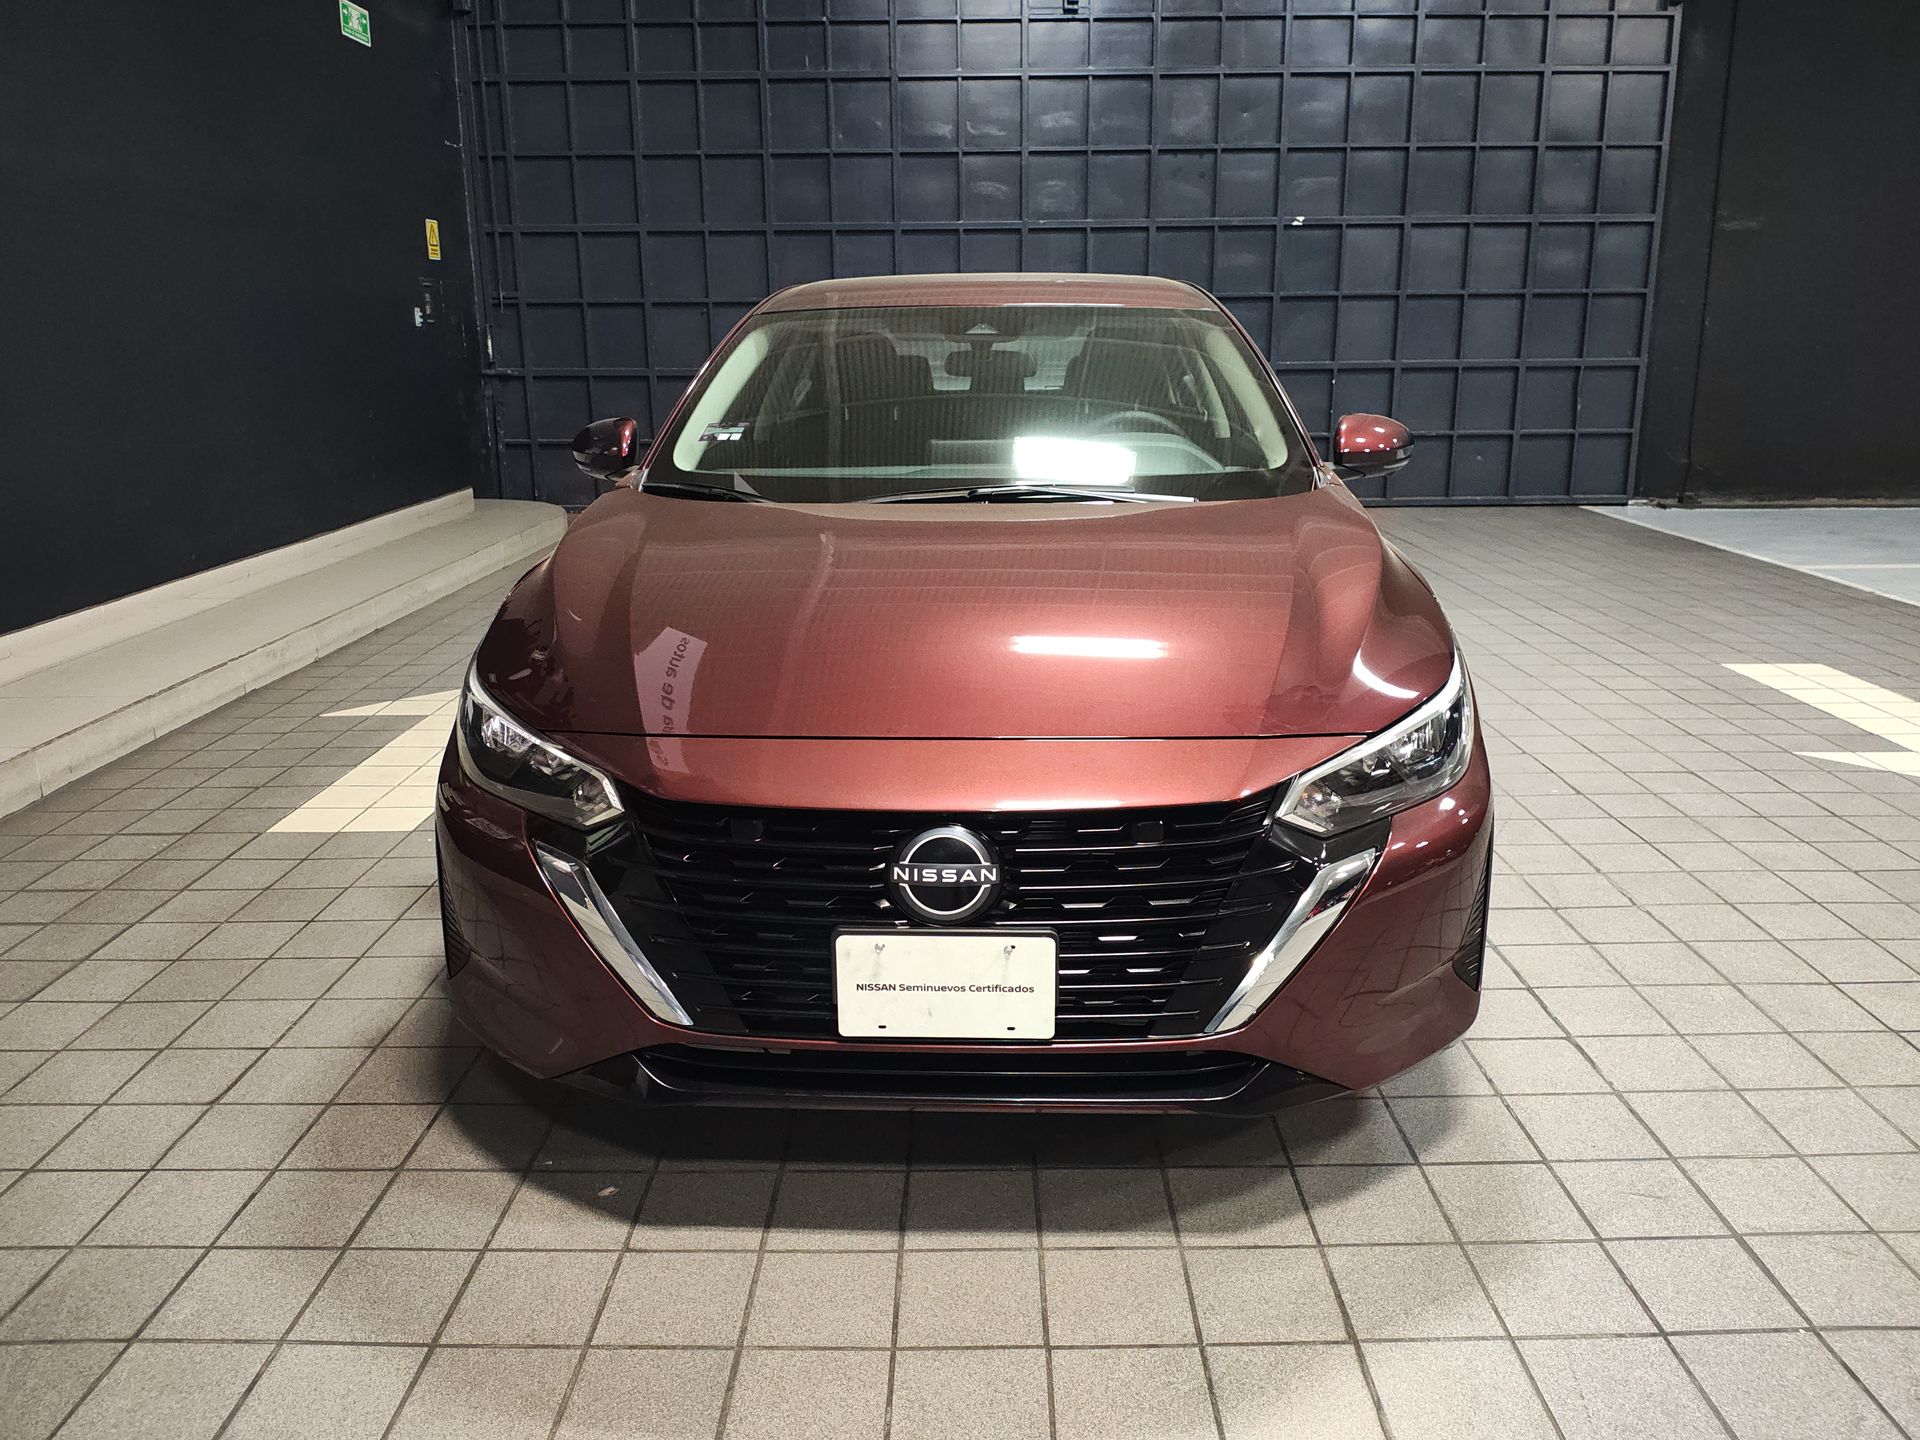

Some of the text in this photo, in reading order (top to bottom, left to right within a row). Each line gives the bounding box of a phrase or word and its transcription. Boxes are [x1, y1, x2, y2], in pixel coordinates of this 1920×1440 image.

[893, 866, 997, 883] NISSAN
[856, 983, 1035, 994] NISSAN Seminuevos Certificados
